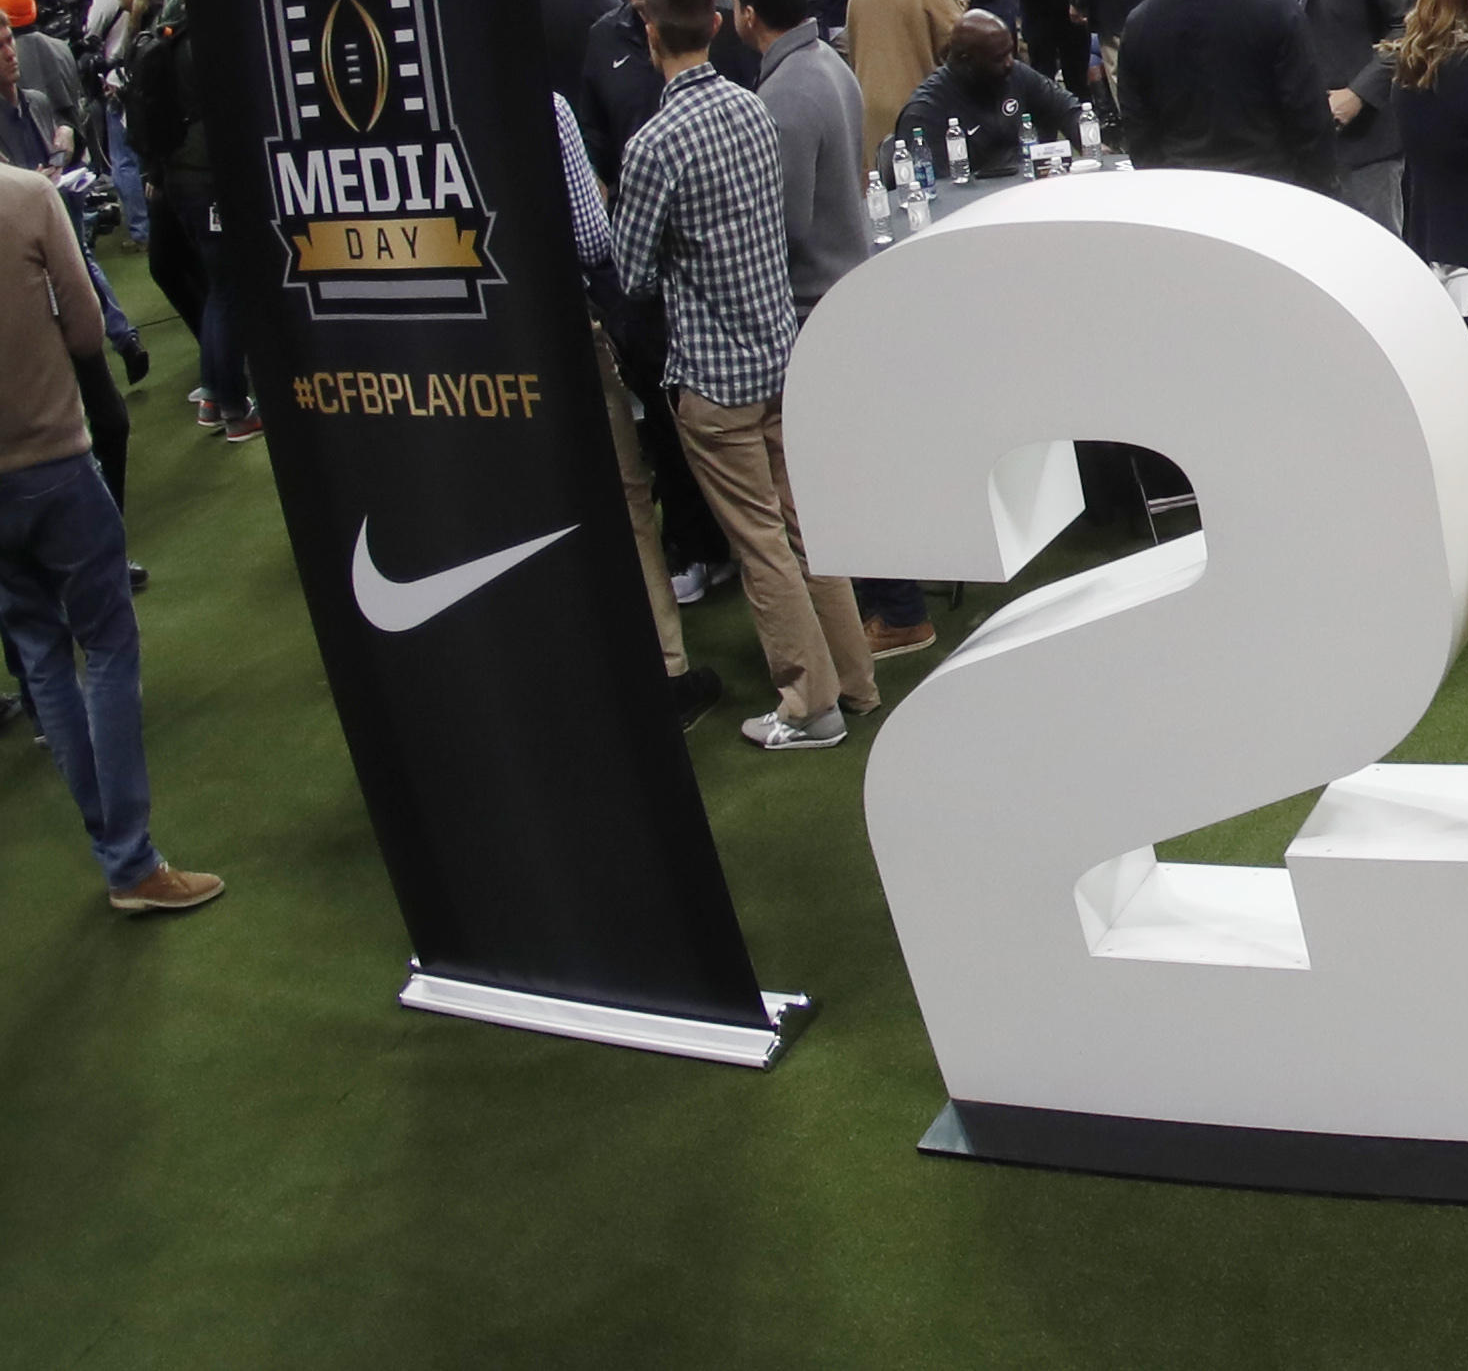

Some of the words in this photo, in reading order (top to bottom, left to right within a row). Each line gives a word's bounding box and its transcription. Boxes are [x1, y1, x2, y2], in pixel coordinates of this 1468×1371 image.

[274, 142, 475, 216] MEDIA
[344, 226, 420, 262] DAY
[292, 371, 542, 419] #CFBPLAYOFF
